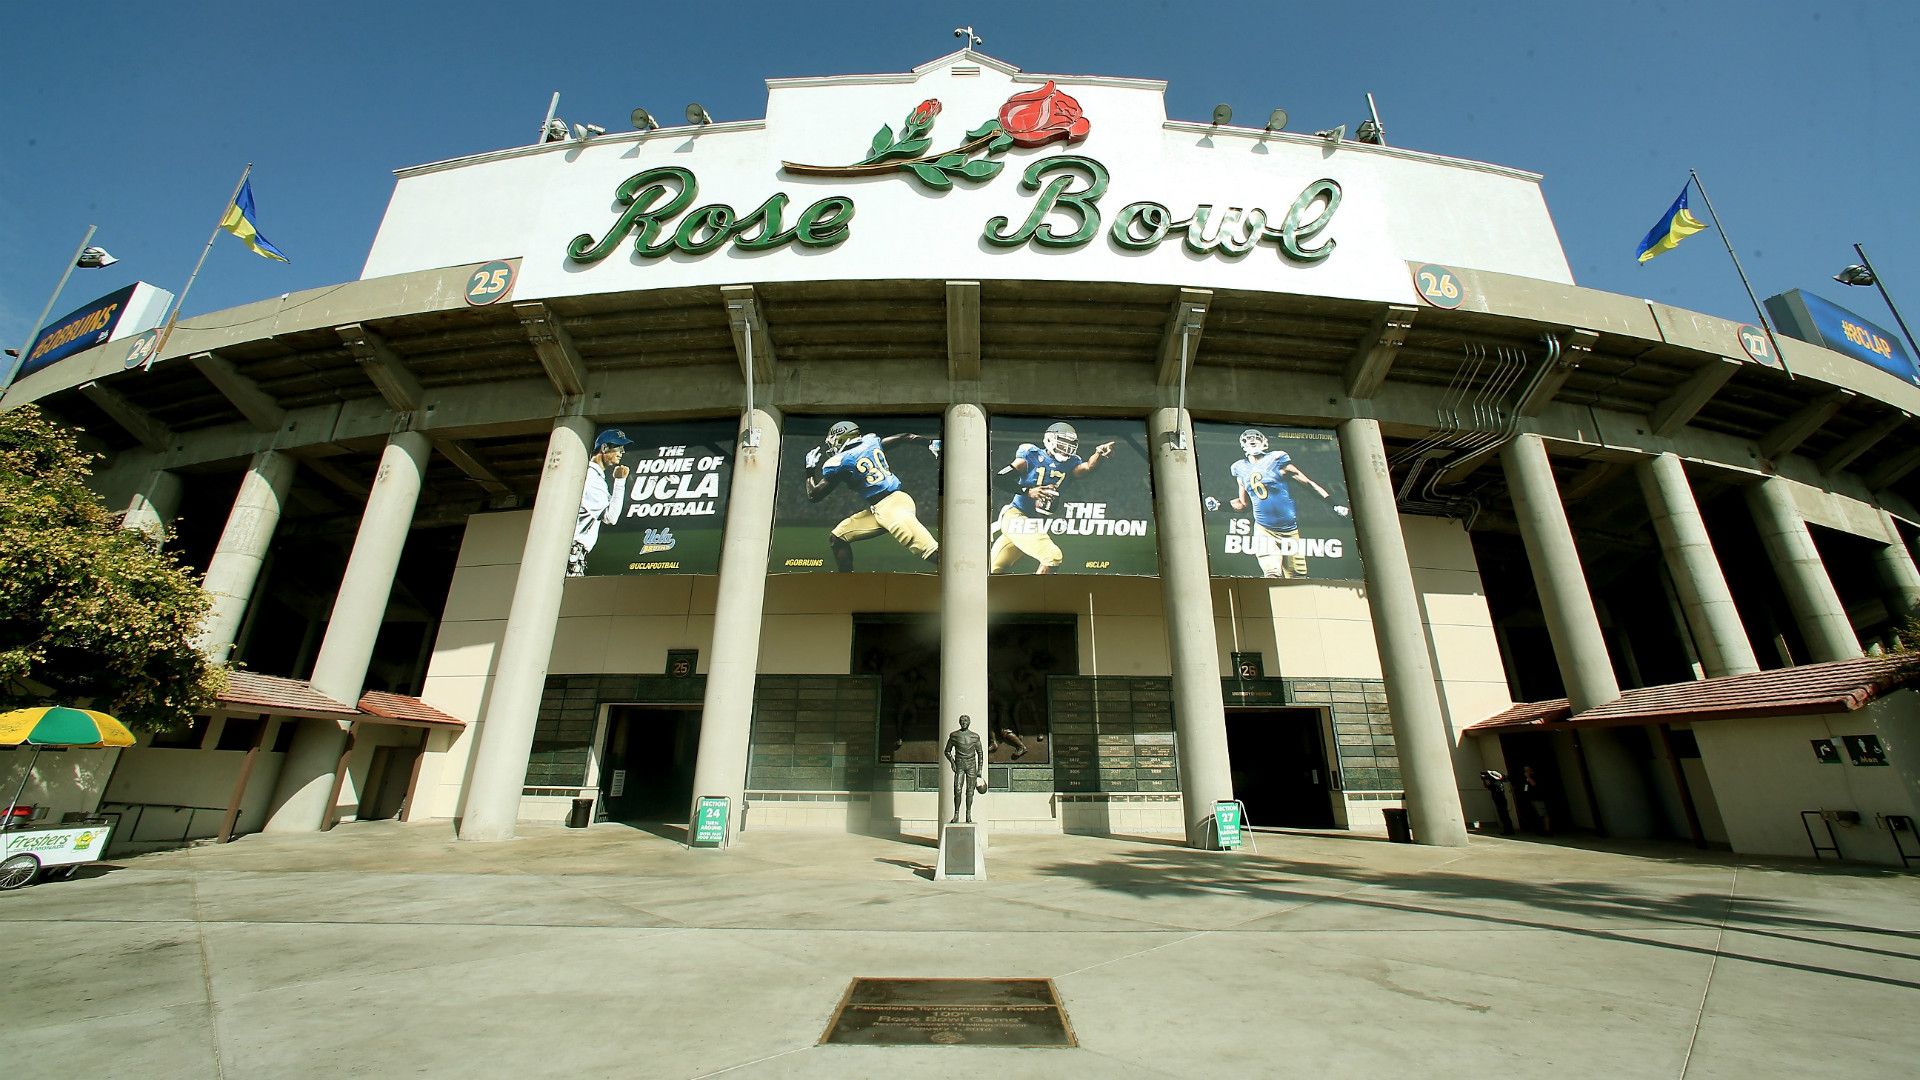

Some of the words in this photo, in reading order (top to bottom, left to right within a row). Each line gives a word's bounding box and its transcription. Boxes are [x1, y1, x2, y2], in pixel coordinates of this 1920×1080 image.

[567, 166, 855, 264] Rose
[983, 155, 1342, 262] Bowl
[470, 269, 508, 296] 25
[1420, 272, 1458, 299] 26
[126, 334, 156, 361] 24
[1743, 333, 1768, 357] 27
[658, 445, 686, 457] THE
[636, 457, 695, 474] HOME
[697, 456, 724, 472] OF
[857, 448, 892, 485] 30
[630, 473, 719, 501] UCLA
[1036, 466, 1066, 490] 17
[1249, 471, 1268, 500] 6
[626, 501, 716, 518] FOOTBALL
[1063, 502, 1107, 519] THE
[1007, 518, 1147, 537] REVOLUTION
[1229, 518, 1250, 535] IS
[1225, 534, 1343, 558] BUILDING
[629, 562, 680, 570] @UCLAFOOTBALL
[785, 559, 824, 567] #GOBRUINS
[673, 662, 688, 674] 25
[1241, 665, 1257, 677] 26
[705, 808, 721, 819] 24
[1221, 812, 1234, 823] 27
[8, 833, 71, 849] Freshers
